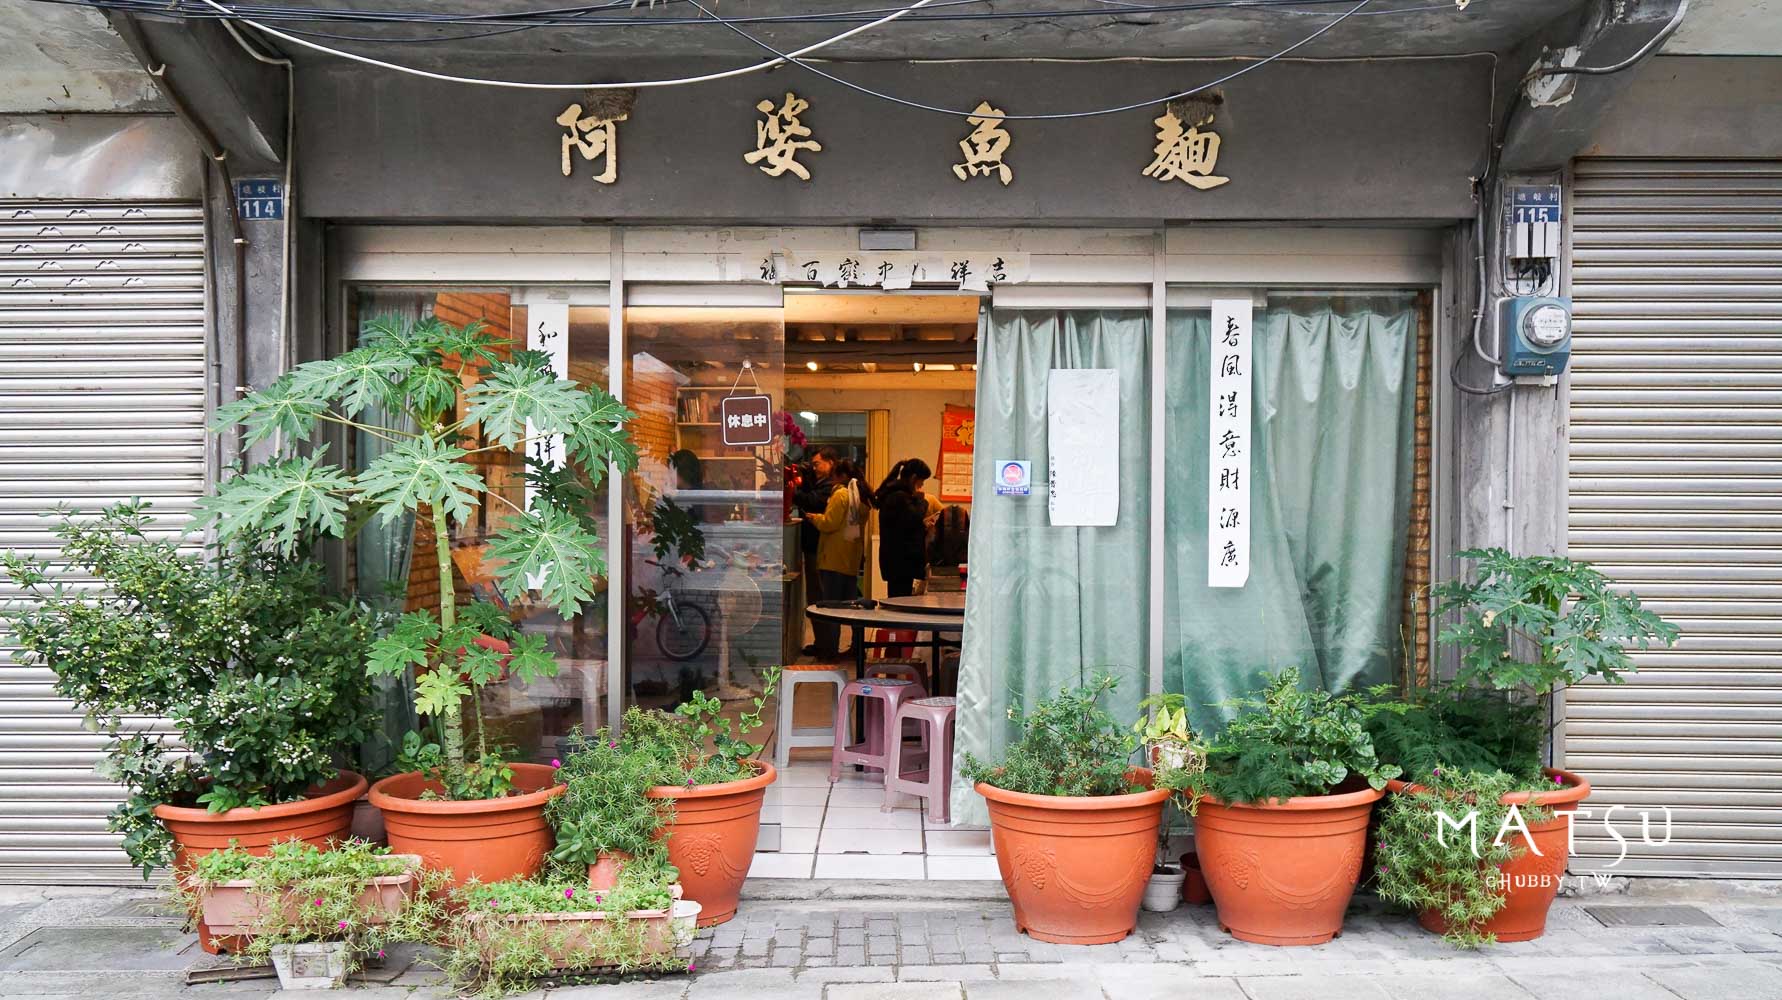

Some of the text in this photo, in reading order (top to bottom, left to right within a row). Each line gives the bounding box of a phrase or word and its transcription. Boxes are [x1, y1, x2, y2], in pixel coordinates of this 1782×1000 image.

[557, 93, 1230, 189] 阿婆魚麵
[243, 201, 275, 218] 114
[1517, 207, 1549, 223] 115
[727, 413, 767, 428] 休息中
